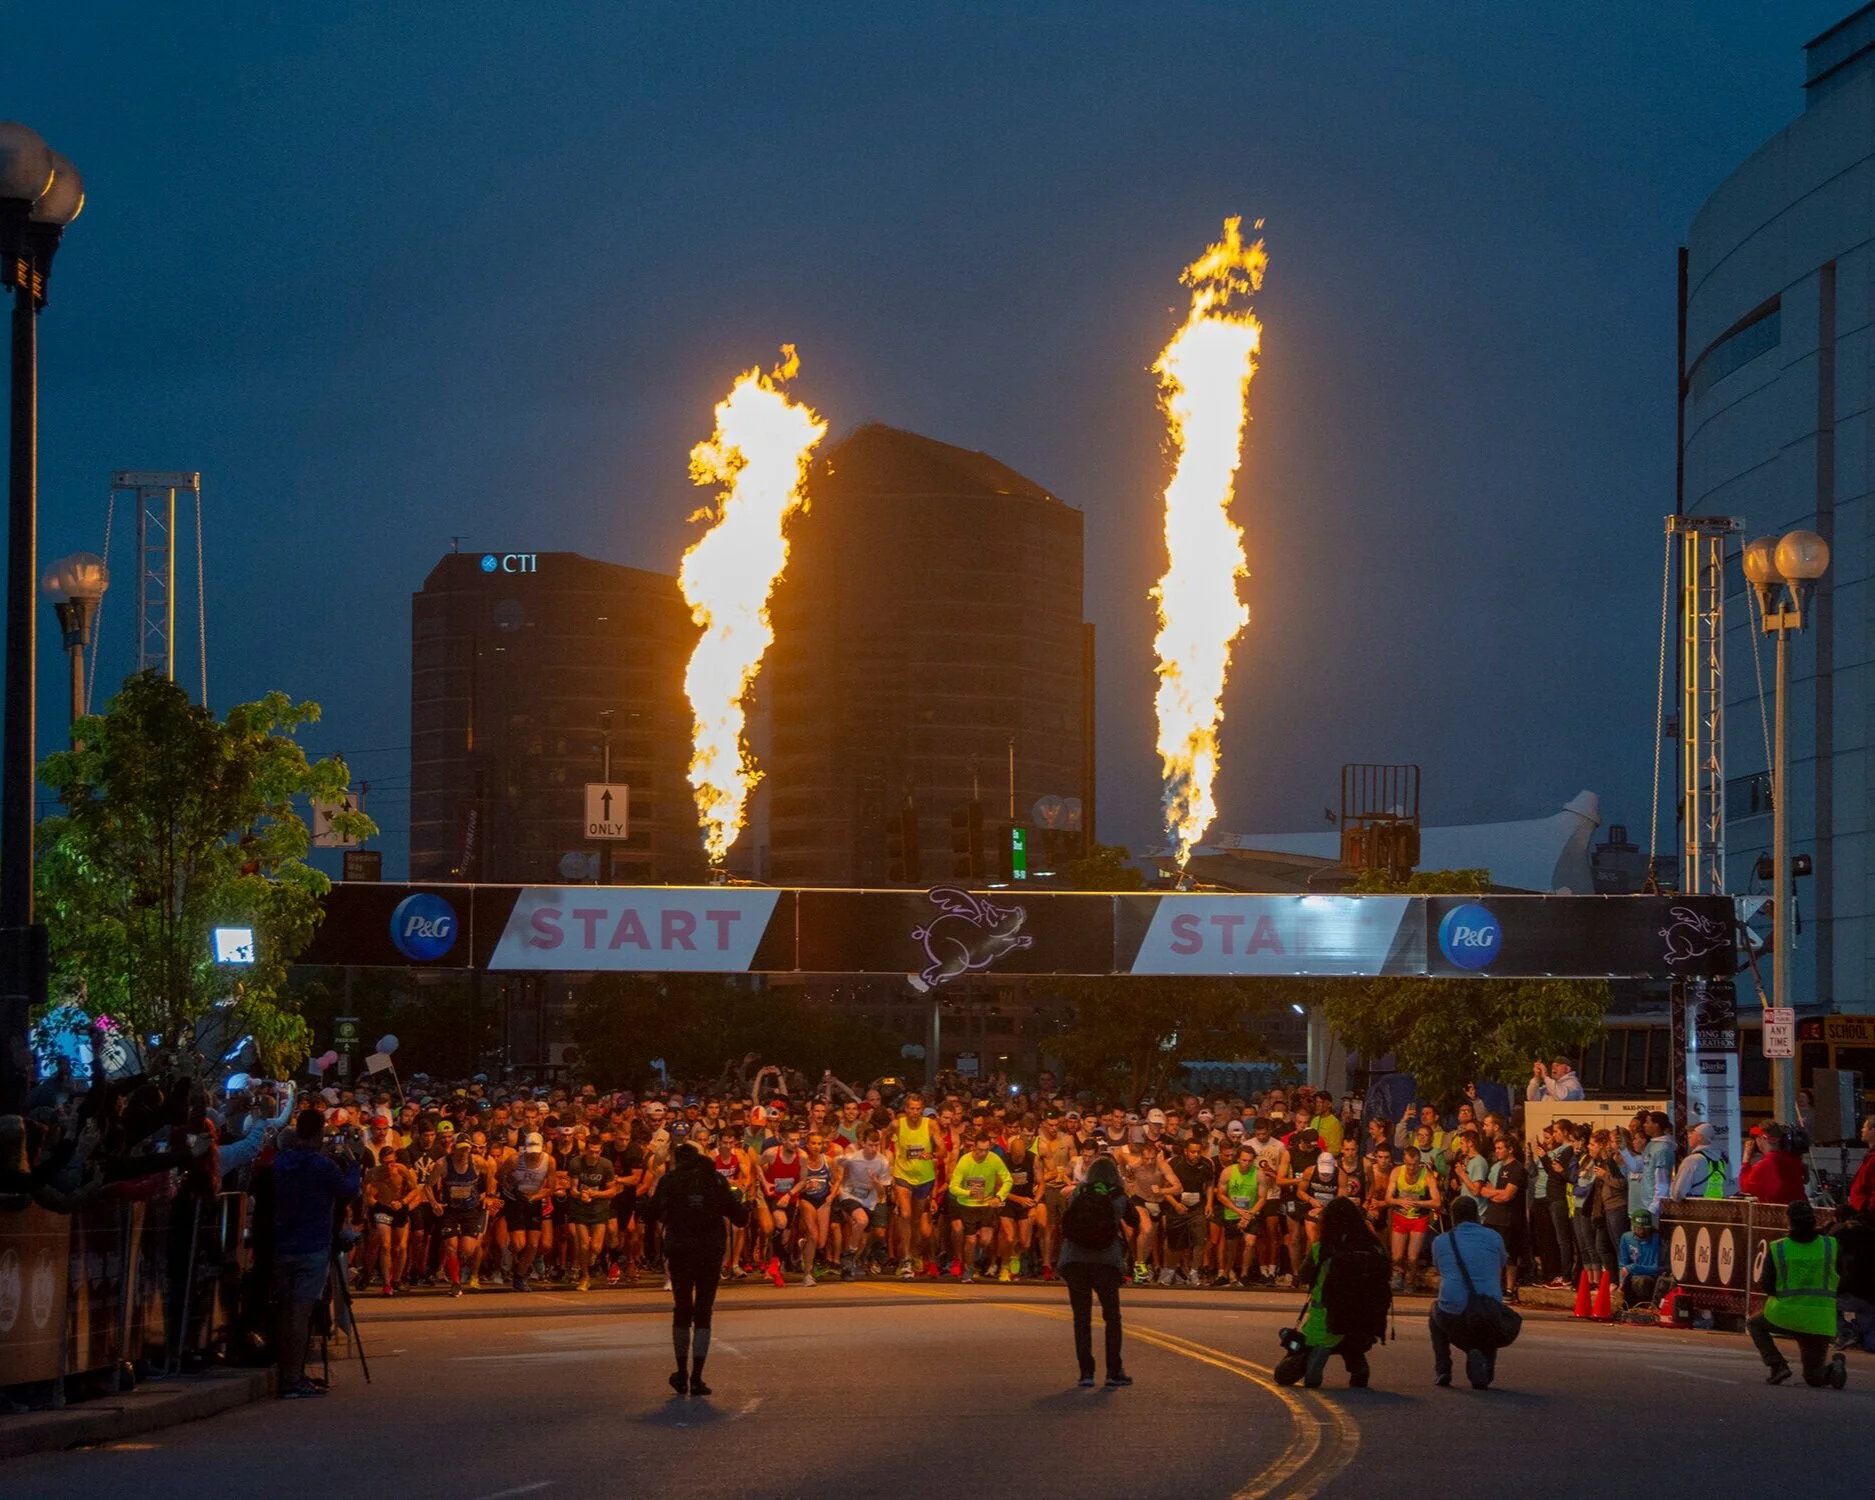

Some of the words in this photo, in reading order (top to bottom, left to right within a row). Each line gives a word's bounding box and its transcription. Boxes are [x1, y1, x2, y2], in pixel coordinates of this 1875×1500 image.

[503, 554, 537, 573] CTI
[589, 823, 624, 835] ONLY
[404, 916, 451, 938] P&G
[529, 907, 742, 950] START
[1452, 926, 1495, 947] P&G
[1770, 1026, 1787, 1035] ANY
[1829, 1023, 1868, 1039] SCHOOL
[1769, 1037, 1788, 1047] TIME
